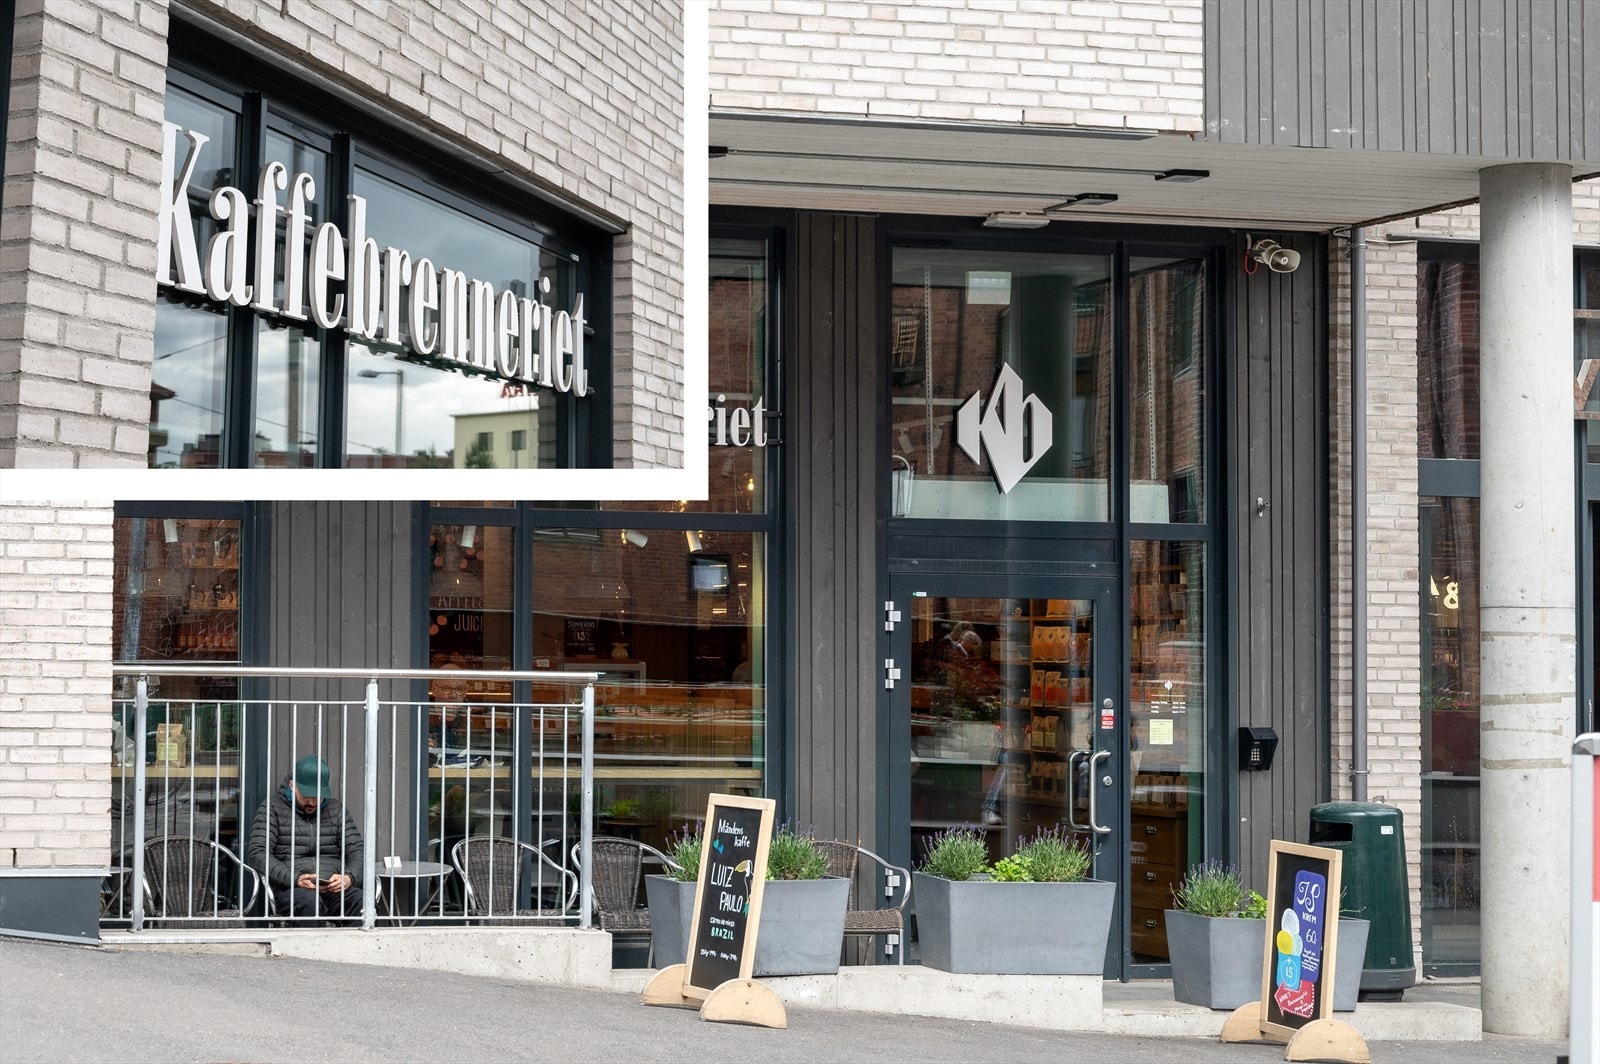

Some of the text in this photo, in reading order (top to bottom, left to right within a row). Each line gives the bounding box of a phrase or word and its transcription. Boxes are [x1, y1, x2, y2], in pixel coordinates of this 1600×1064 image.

[156, 120, 588, 398] Kaffebrenneriet
[733, 835, 751, 848] kaffe
[710, 862, 735, 888] LUIZ
[719, 890, 744, 913] PAULO
[1302, 911, 1317, 925] KREM
[710, 926, 734, 940] BRAZIL
[1285, 966, 1294, 979] IS
